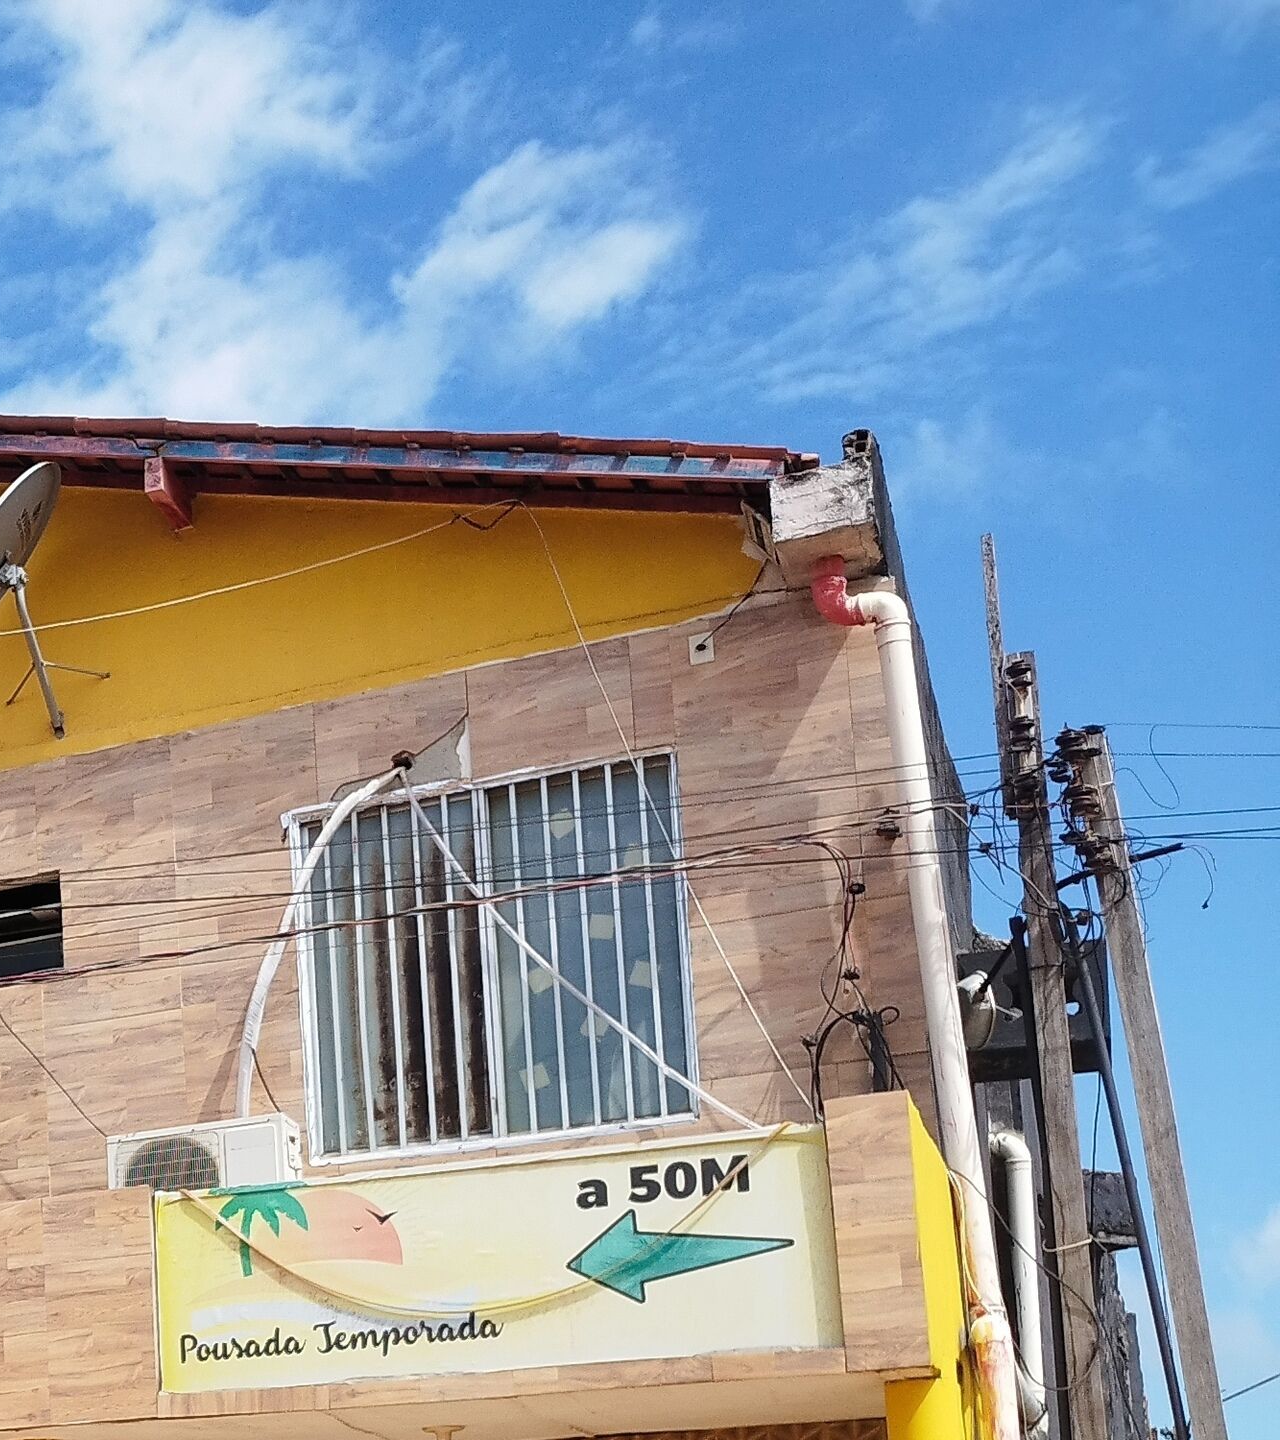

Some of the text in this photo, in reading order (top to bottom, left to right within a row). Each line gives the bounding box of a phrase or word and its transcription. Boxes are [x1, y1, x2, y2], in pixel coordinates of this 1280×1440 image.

[576, 1154, 750, 1210] a 50M
[180, 1311, 504, 1364] Pousada Temporada
